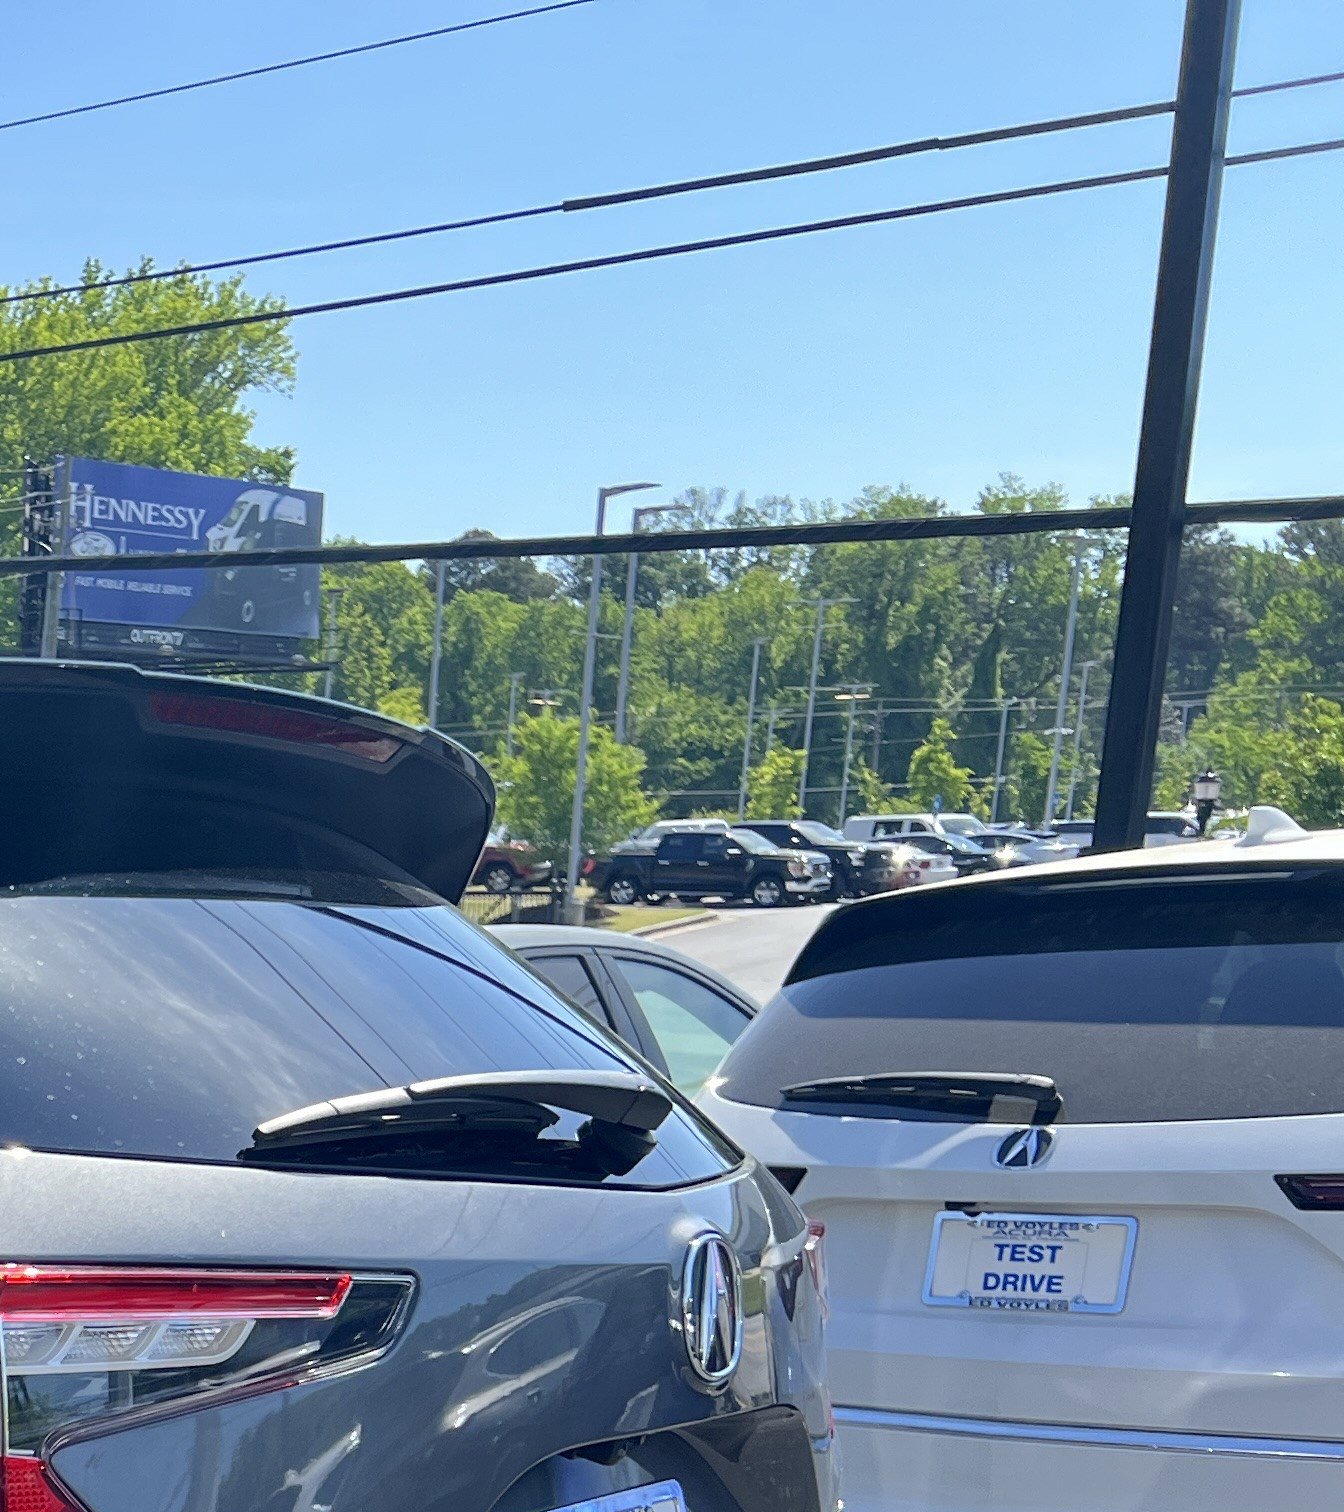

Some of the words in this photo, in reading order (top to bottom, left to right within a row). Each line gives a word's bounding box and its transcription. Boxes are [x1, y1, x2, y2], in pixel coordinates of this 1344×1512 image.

[68, 482, 206, 540] HENNESSY
[992, 1229, 1070, 1238] ACURA
[994, 1243, 1063, 1264] TEST
[982, 1272, 1064, 1294] DRIVE
